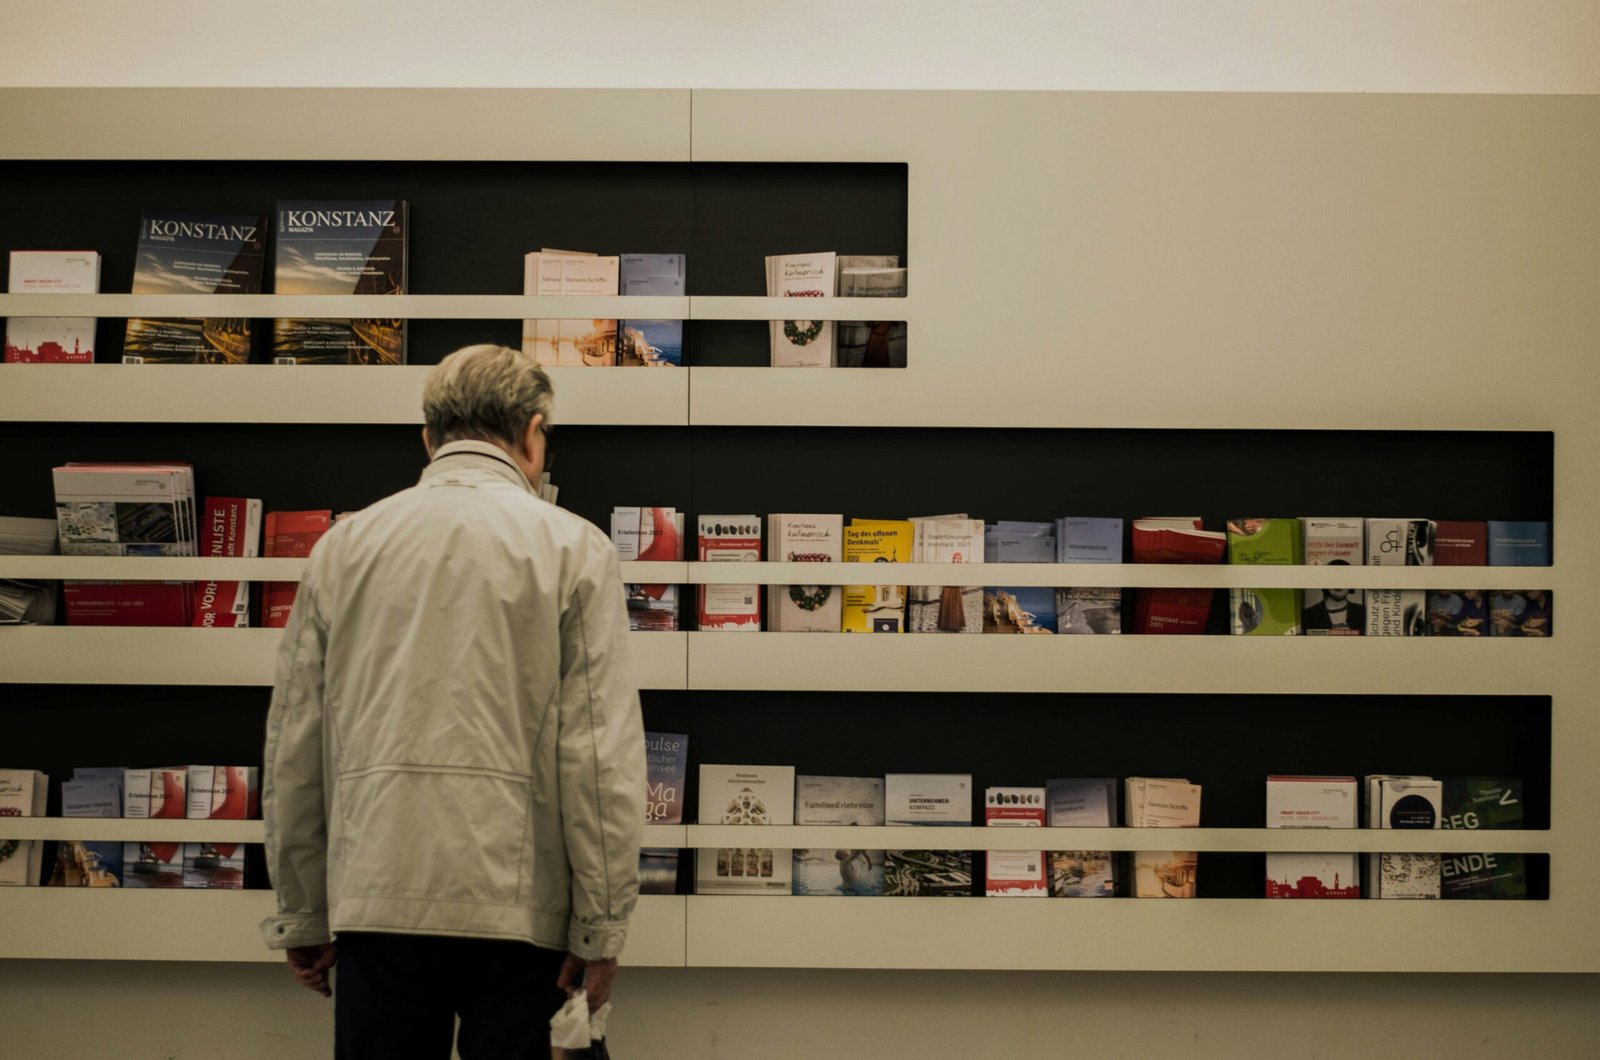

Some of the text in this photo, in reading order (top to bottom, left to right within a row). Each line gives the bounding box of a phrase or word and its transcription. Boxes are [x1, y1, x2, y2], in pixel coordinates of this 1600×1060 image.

[288, 210, 396, 228] KONSTANZ
[150, 219, 257, 242] KONSTANZ
[150, 235, 175, 243] MAGAZIN
[227, 504, 238, 542] Konstanz
[847, 530, 859, 539] Tag
[1336, 541, 1359, 549] Gewalt
[805, 800, 875, 809] FamilienErlebnisse
